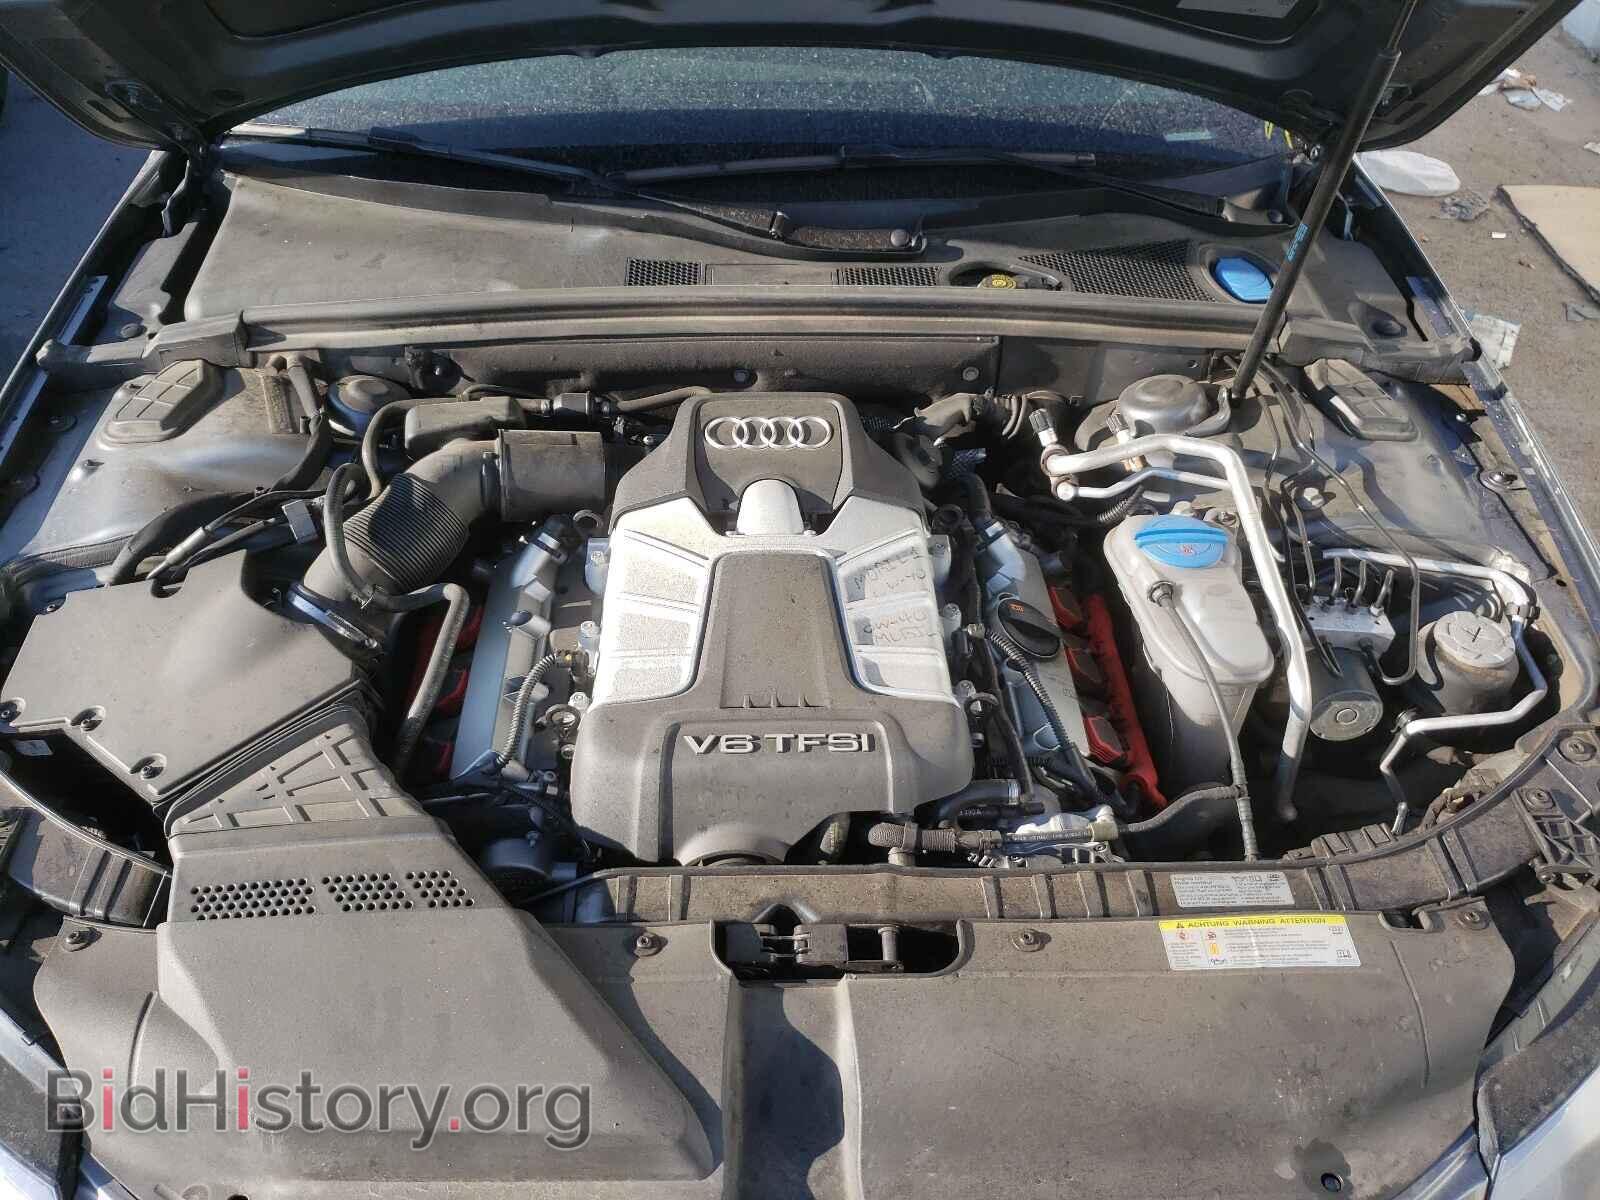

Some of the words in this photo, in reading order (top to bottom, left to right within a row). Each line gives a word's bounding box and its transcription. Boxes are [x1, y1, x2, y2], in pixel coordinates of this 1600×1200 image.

[683, 733, 762, 756] V6
[765, 732, 874, 754] TFSI
[1188, 921, 1230, 929] ACHTUNG
[1233, 918, 1276, 927] WARNING
[1279, 917, 1326, 926] ATTENTION
